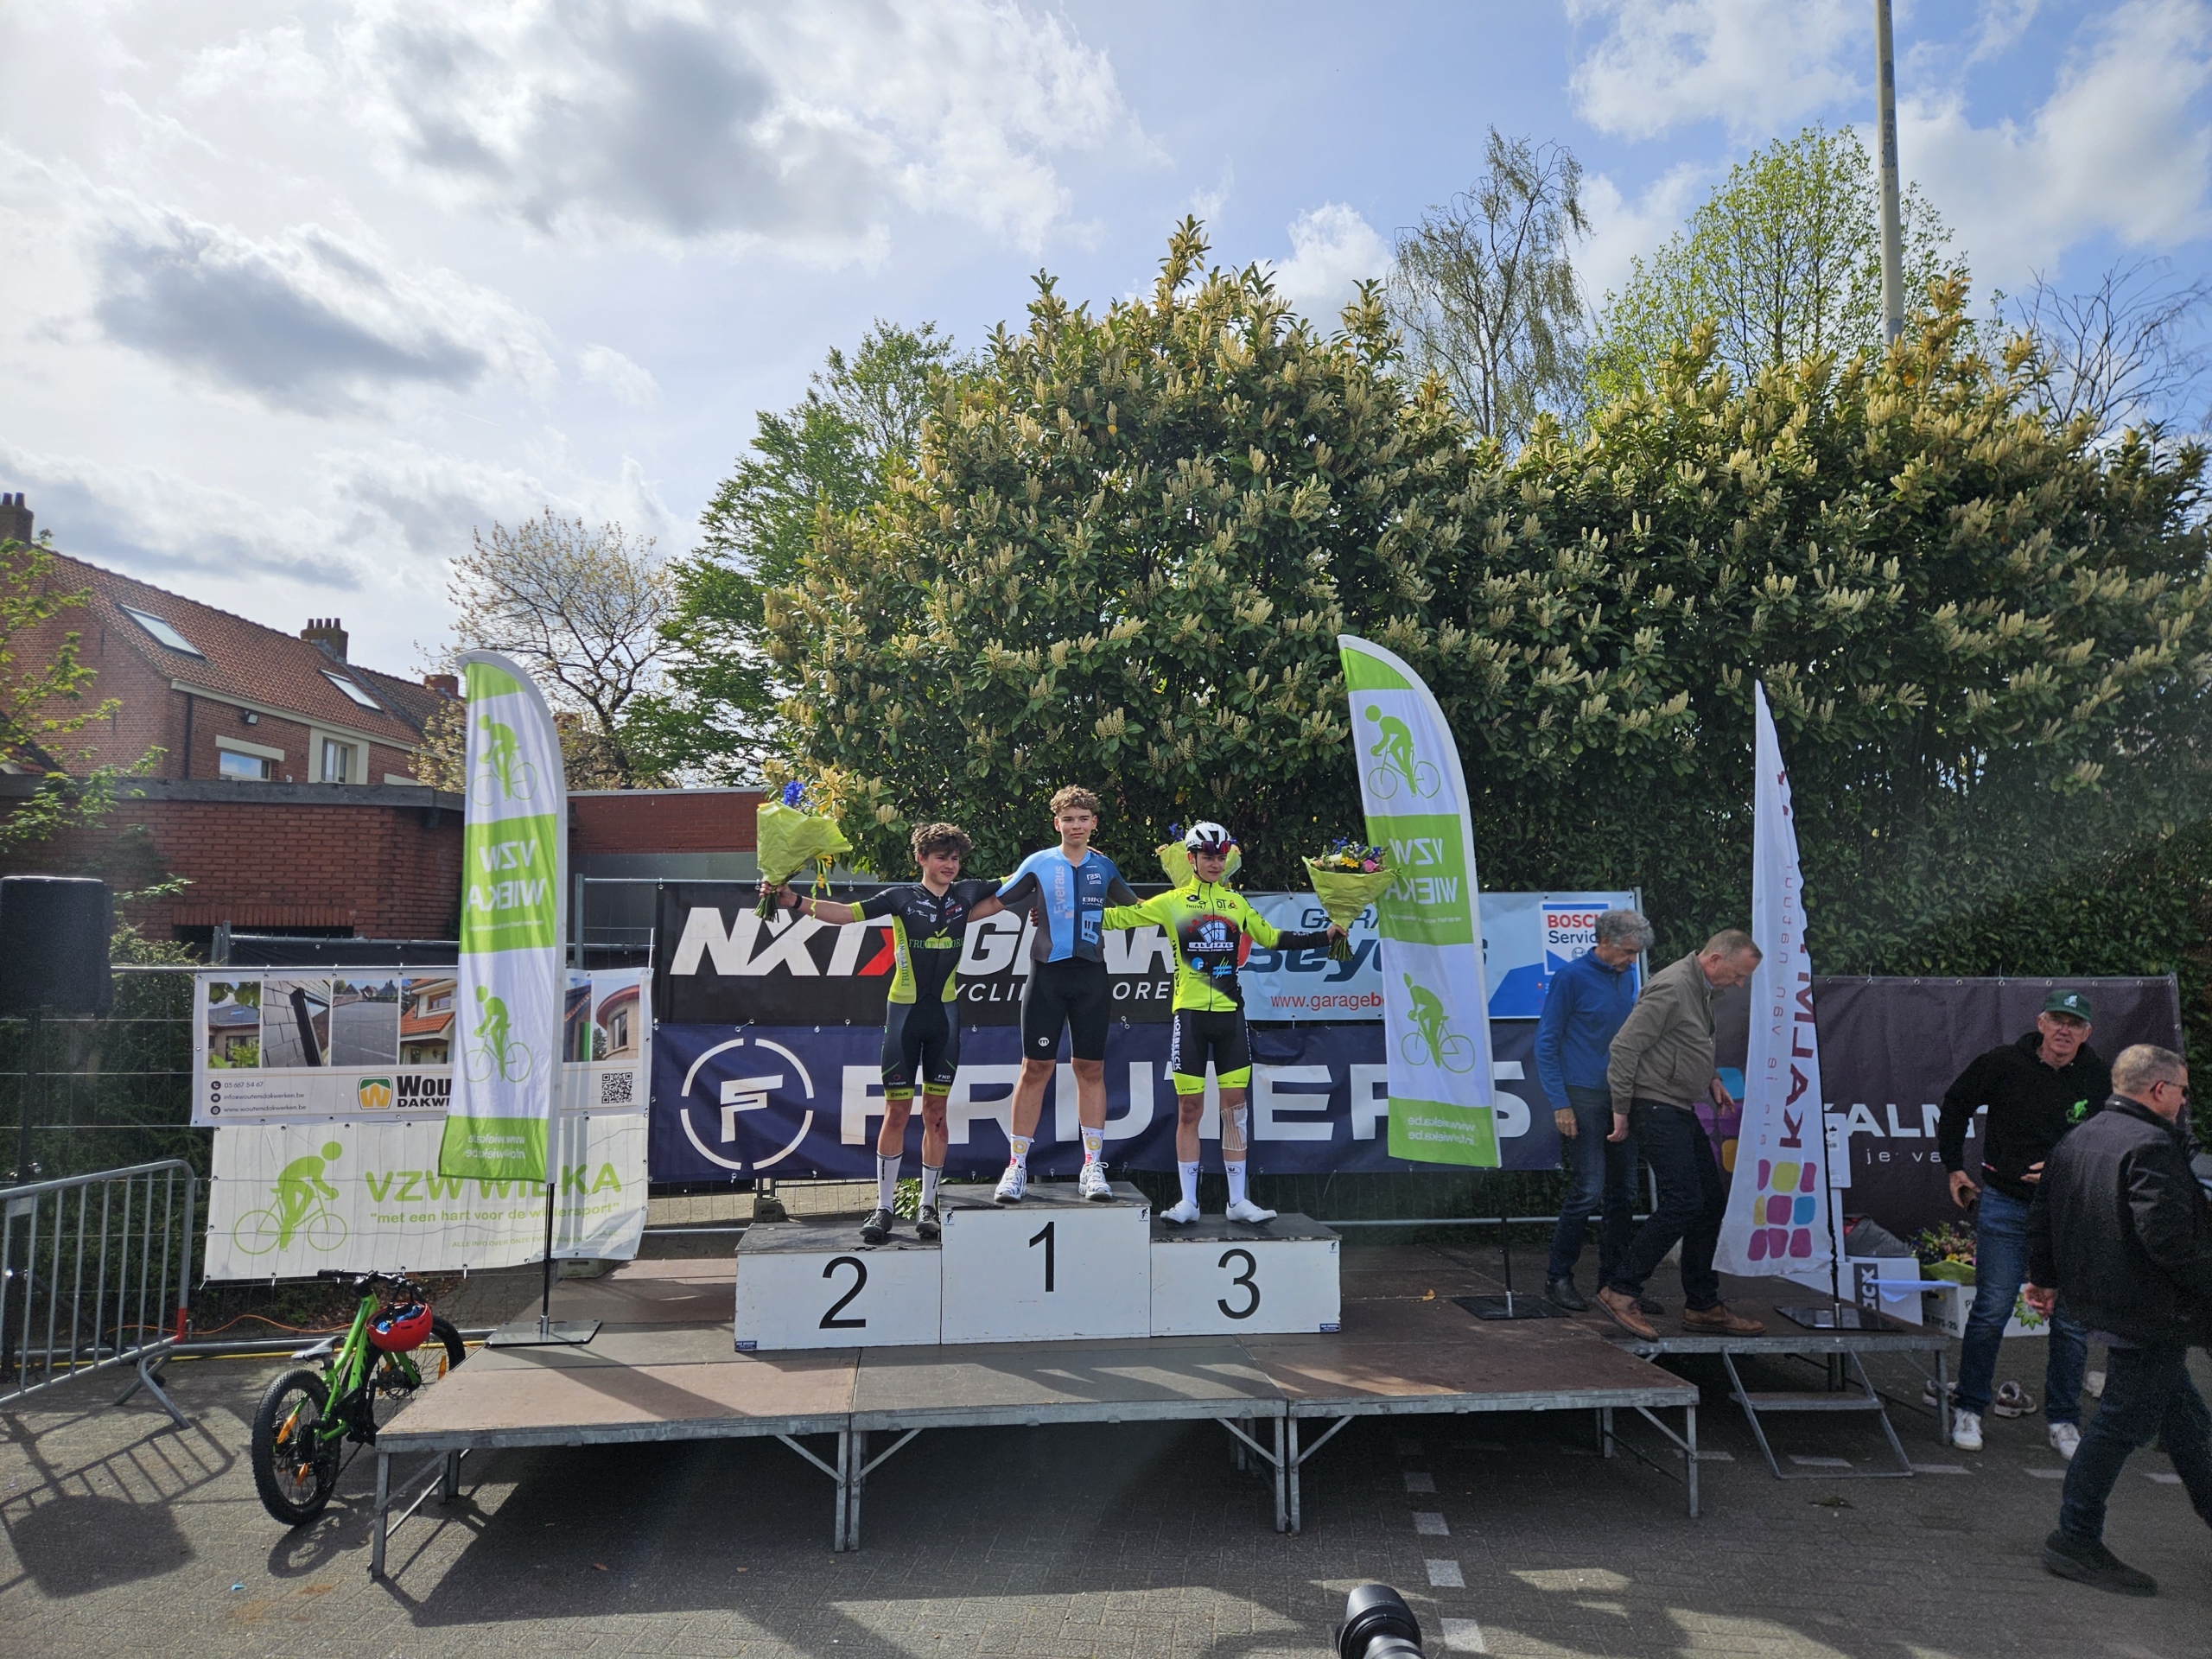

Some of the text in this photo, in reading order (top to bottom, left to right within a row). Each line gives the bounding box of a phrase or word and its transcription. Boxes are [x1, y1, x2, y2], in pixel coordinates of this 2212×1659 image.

[1548, 931, 1599, 944] Servic
[1271, 992, 1384, 1011] www.garageb
[1912, 1151, 1942, 1162] va
[365, 1170, 463, 1202] VZW
[409, 1212, 436, 1223] een
[441, 1210, 471, 1221] hart
[474, 1211, 504, 1220] voor
[508, 1208, 525, 1219] de
[1028, 1221, 1055, 1293] 1
[818, 1255, 868, 1329] 2
[1217, 1249, 1261, 1319] 3
